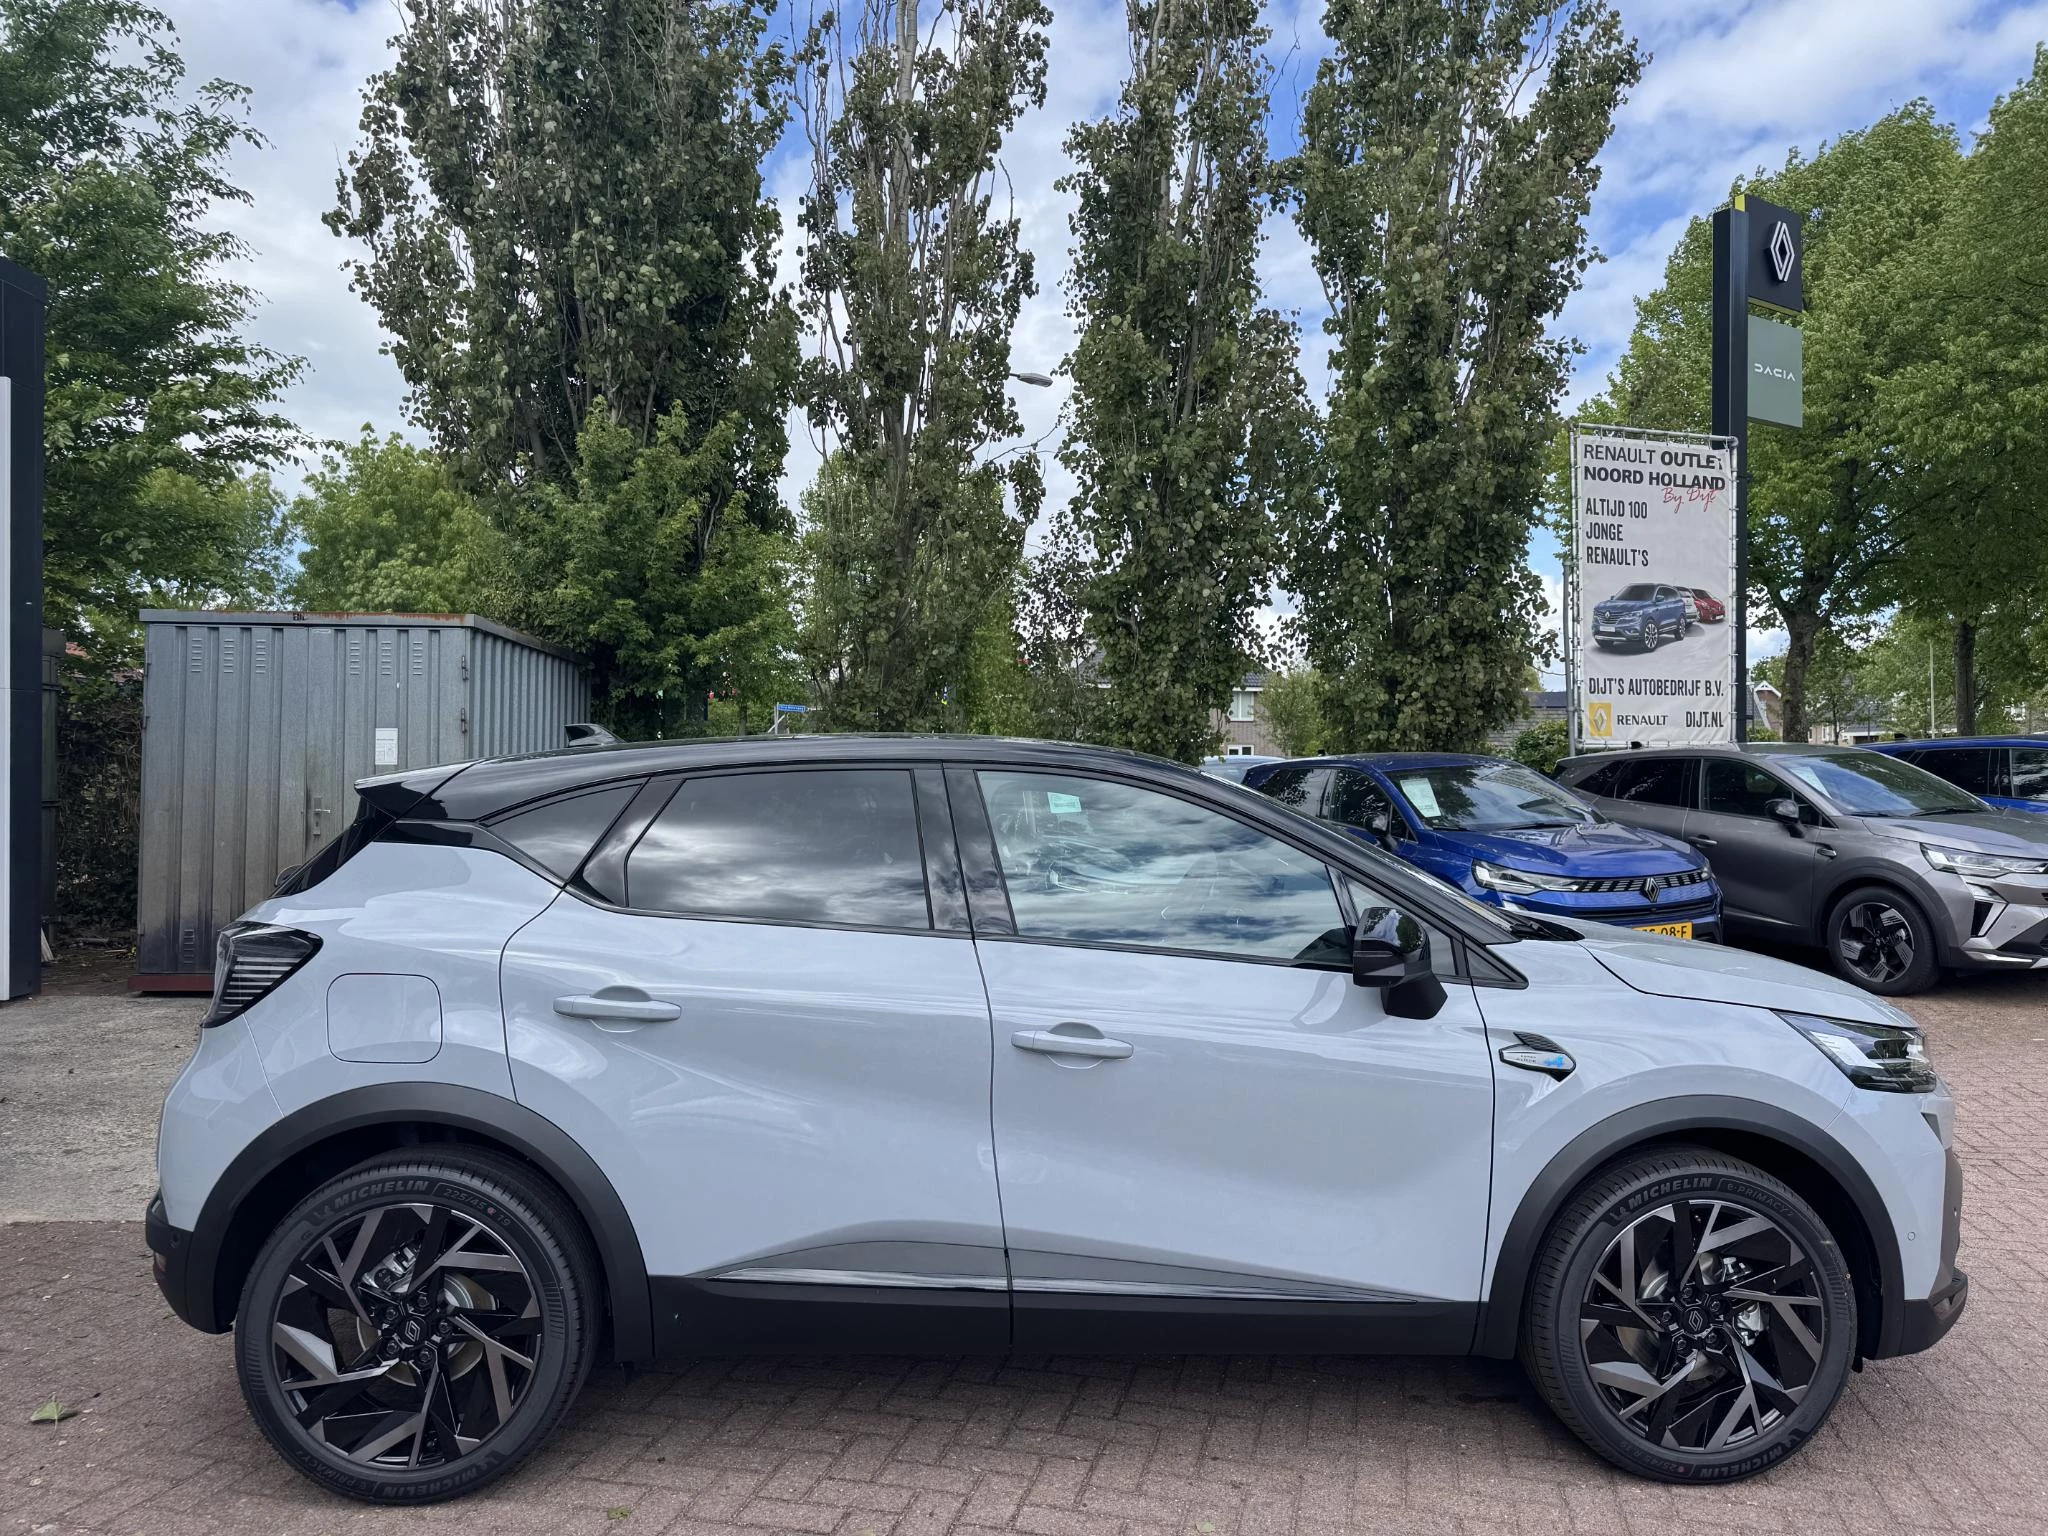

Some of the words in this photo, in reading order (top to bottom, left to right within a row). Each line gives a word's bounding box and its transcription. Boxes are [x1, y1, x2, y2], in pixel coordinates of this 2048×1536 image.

[1754, 363, 1796, 382] DACIA
[1584, 444, 1656, 465] RENAULT
[1584, 466, 1644, 484] NOORD
[1649, 471, 1726, 491] HOLLAND
[1586, 497, 1625, 517] ALTIJD
[1628, 501, 1648, 519] 100
[1586, 522, 1624, 541] JONGE
[1586, 546, 1649, 566] RENAULT'S
[1589, 677, 1625, 695] DIJT'S
[1628, 679, 1701, 696] AUTOBEDRIJF
[1705, 680, 1724, 697] B.V.
[1617, 714, 1669, 726] RENAULT
[1686, 711, 1724, 728] DIJT.NL
[334, 1180, 430, 1208] MICHELIN
[1628, 1177, 1713, 1208] MICHELIN
[1701, 1445, 1783, 1477] MICHELIN
[383, 1468, 478, 1497] MICHELIN
